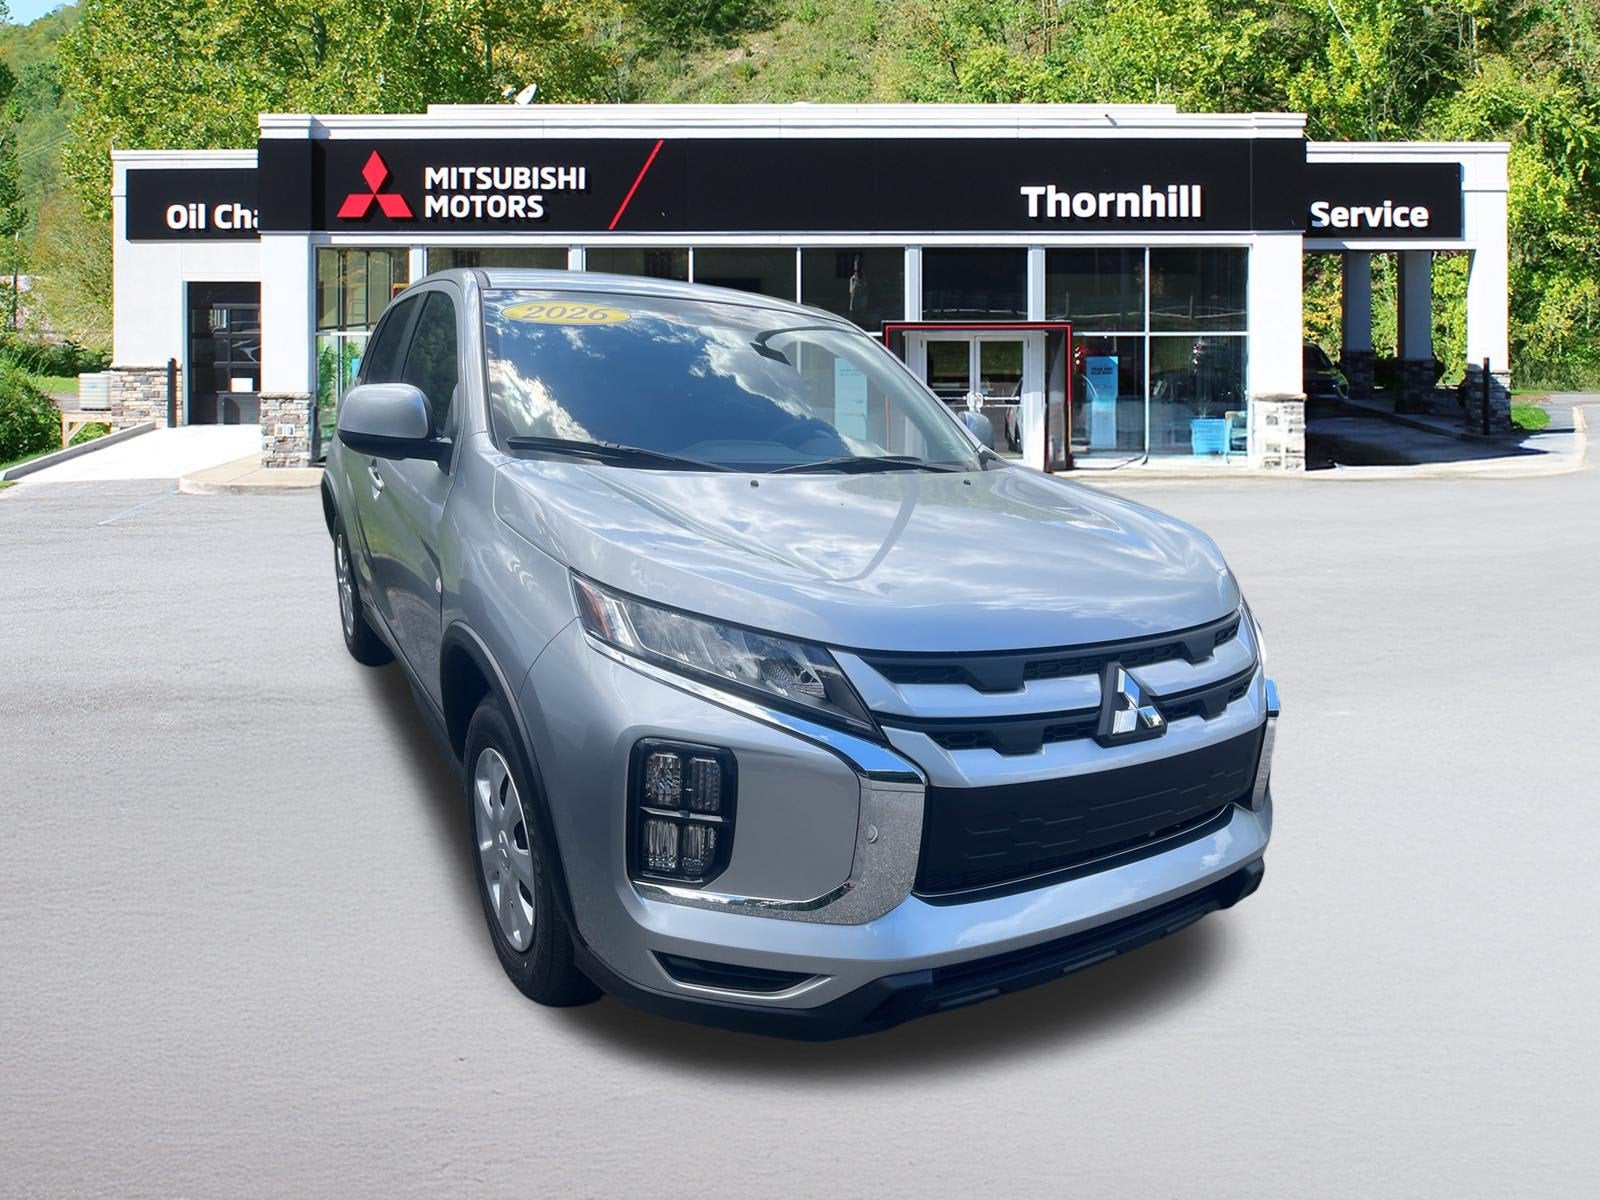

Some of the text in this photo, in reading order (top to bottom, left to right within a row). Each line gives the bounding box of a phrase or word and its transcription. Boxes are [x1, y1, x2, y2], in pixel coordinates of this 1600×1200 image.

[424, 166, 587, 191] MITSUBISHI
[424, 194, 544, 219] MOTORS
[1020, 185, 1202, 218] Thornhill
[1310, 200, 1430, 228] Service
[165, 203, 206, 230] Oil
[522, 305, 610, 321] 2026
